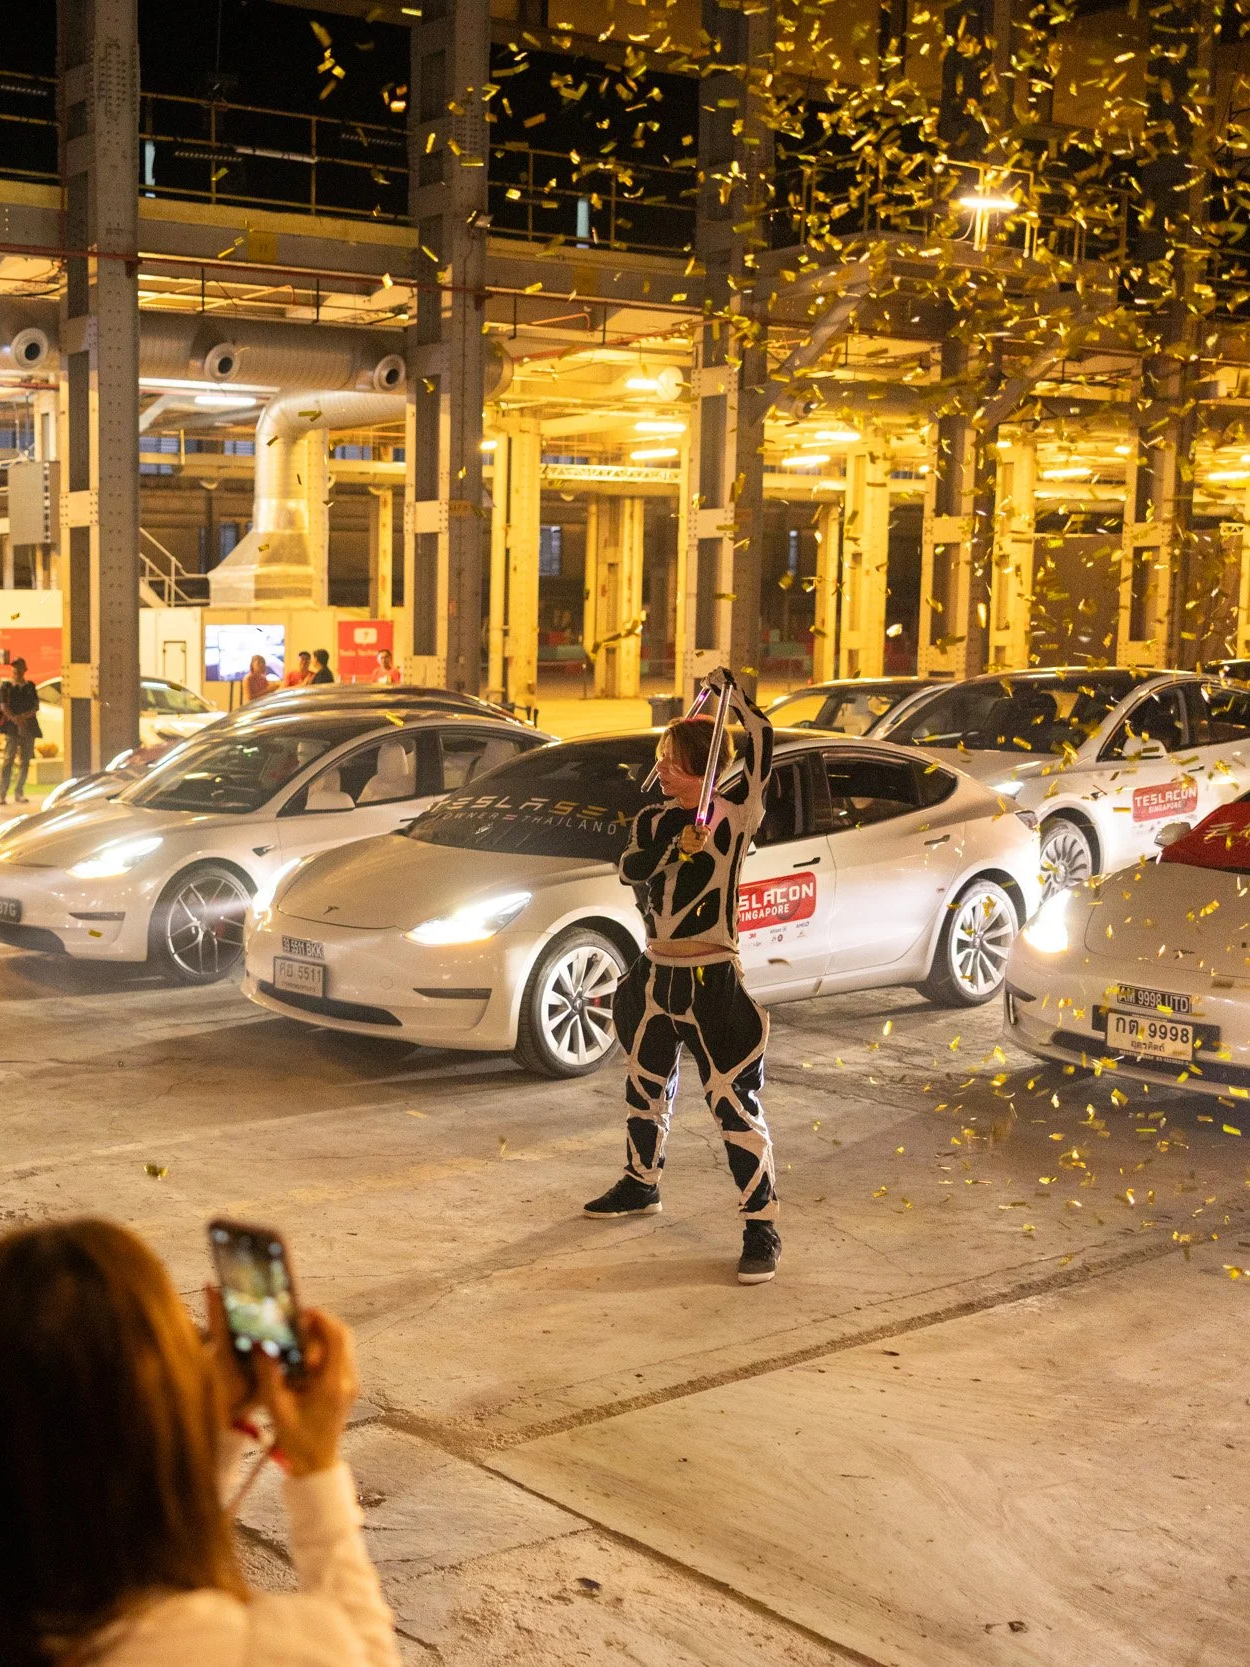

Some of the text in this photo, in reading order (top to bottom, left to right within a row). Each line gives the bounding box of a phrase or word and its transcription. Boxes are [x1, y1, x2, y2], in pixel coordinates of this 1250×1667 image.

[1135, 787, 1197, 807] TESLACON
[1148, 801, 1182, 813] SINGAPORE
[521, 814, 617, 836] THAILAND
[738, 903, 790, 923] INGAPORE
[306, 942, 323, 958] BKK
[298, 966, 321, 983] 5511
[1137, 991, 1162, 1007] 9998
[1148, 1022, 1190, 1044] 9998
